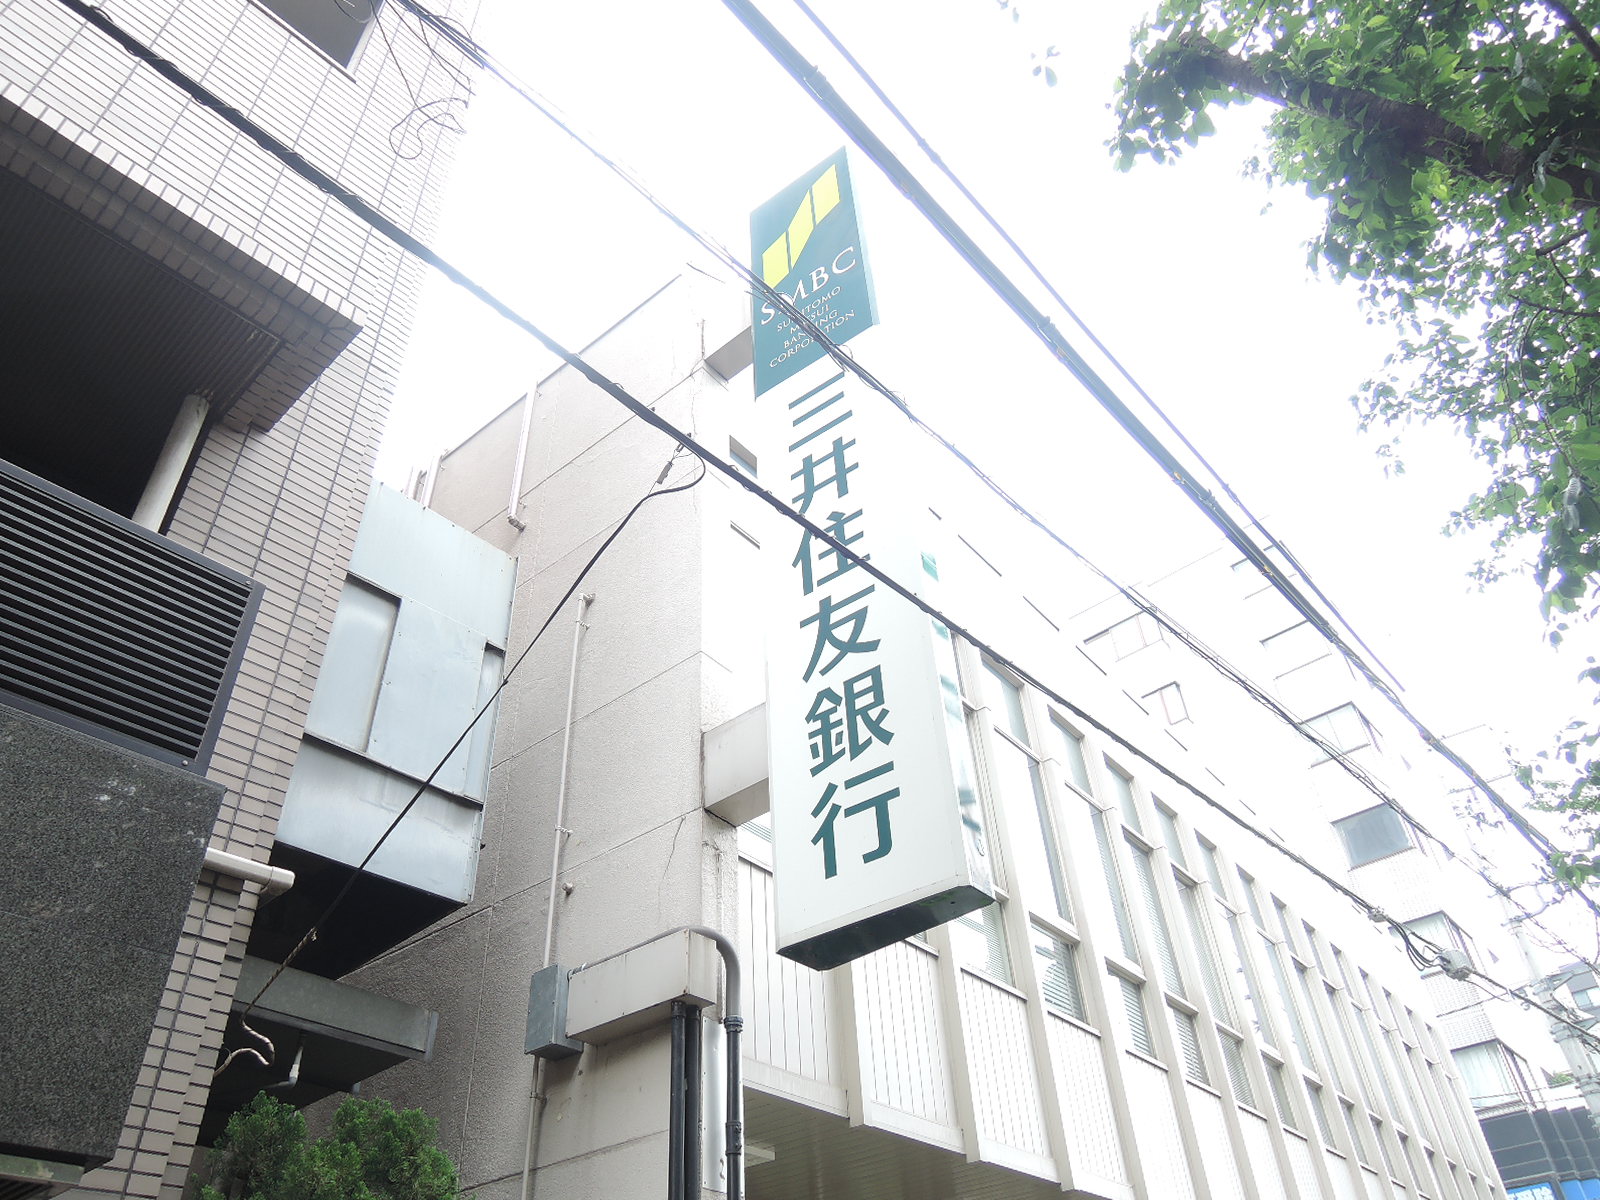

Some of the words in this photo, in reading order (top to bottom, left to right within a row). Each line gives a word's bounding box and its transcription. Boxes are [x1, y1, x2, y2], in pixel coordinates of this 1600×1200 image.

[777, 286, 841, 332] SUITOMO
[783, 310, 838, 349] BANING
[790, 304, 830, 334] MSUI
[769, 309, 855, 368] CORPOTION
[788, 371, 901, 880] 三井住友銀行
